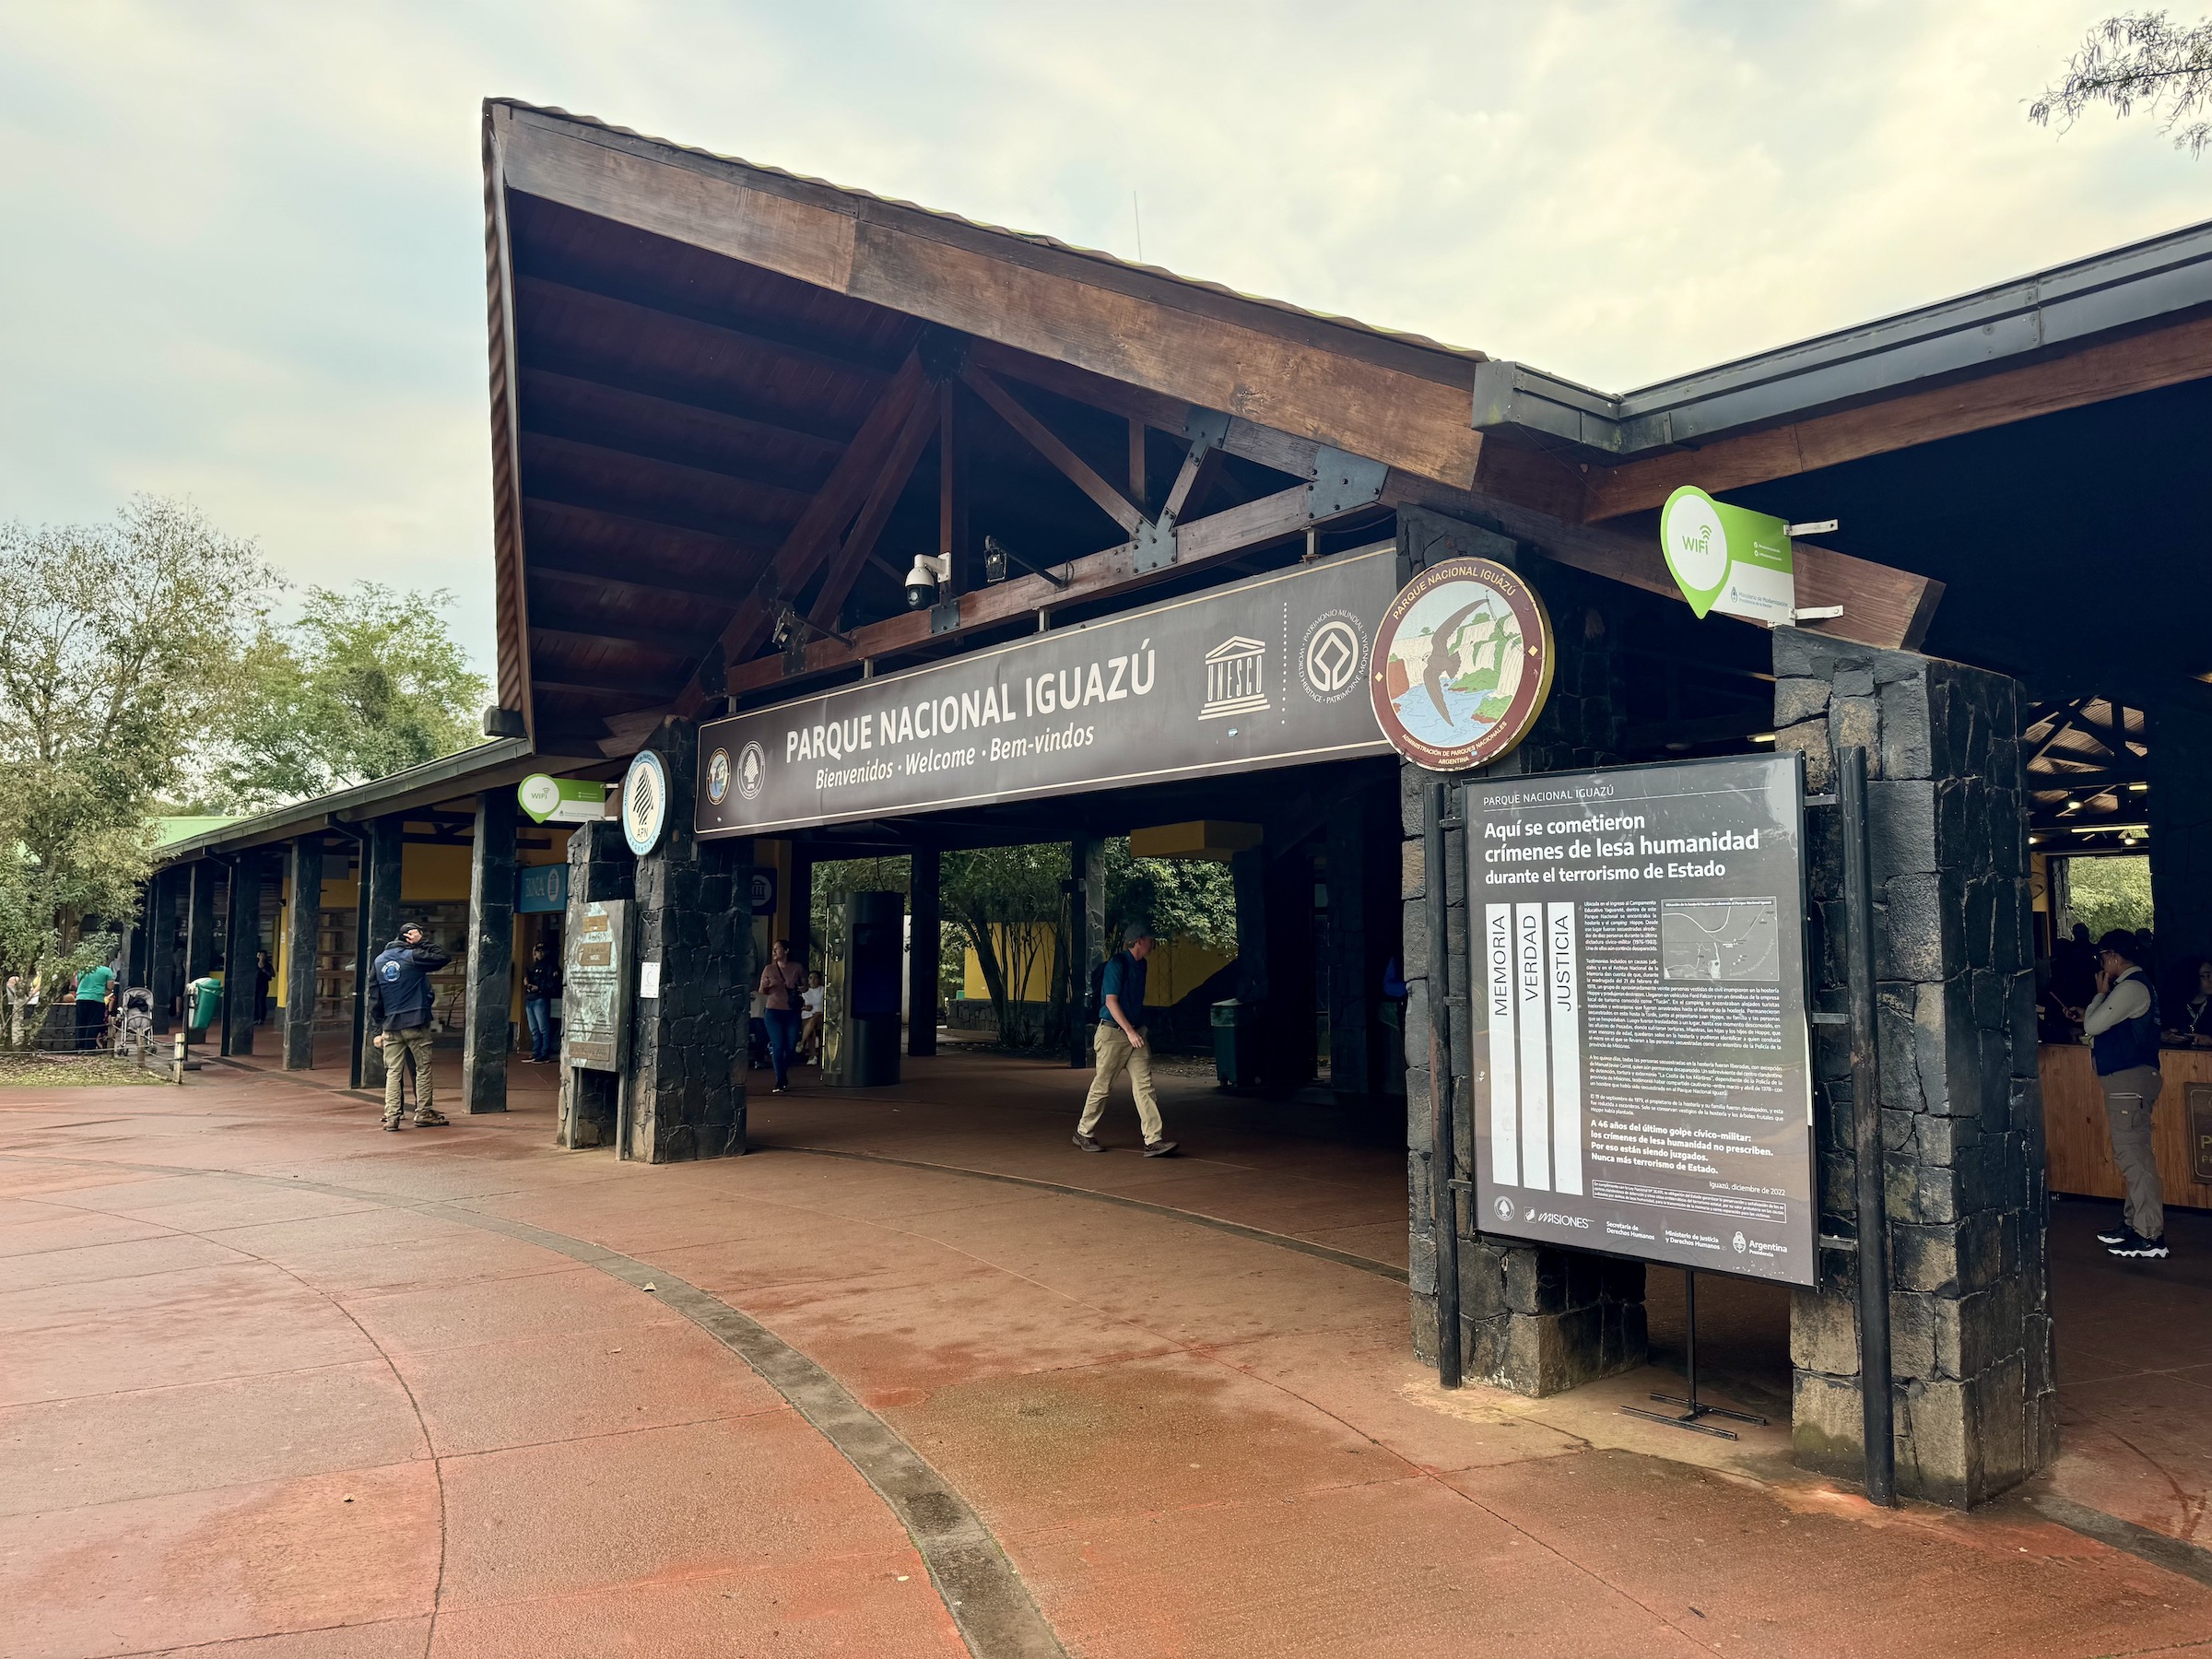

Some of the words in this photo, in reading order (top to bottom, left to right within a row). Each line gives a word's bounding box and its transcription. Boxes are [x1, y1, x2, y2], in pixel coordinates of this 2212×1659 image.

[1392, 582, 1428, 620] PARQUE
[1428, 566, 1478, 586] NACIONAL
[1480, 568, 1516, 596] IGUAZÚ
[1303, 609, 1337, 642] PATRIMONIO
[1337, 609, 1364, 632] MUNDIAL
[1207, 654, 1263, 702] UNESCO
[1326, 674, 1362, 704] PATRIMOINE
[1359, 631, 1369, 675] MONDIAL
[785, 714, 872, 764] PARQUE
[879, 683, 1016, 747] NACIONAL
[1025, 638, 1156, 718] IGUAZÚ
[1300, 677, 1323, 704] HERITAGE
[1401, 734, 1442, 757] ADMINISTRACIÓN
[1450, 745, 1476, 757] PARQUES
[1475, 721, 1507, 751] NACIONALES
[815, 758, 894, 791] Bienvenidos
[904, 745, 976, 776] Welcome
[989, 722, 1096, 762] Bem-vindos
[1438, 756, 1470, 765] ARGENTINA
[1484, 794, 1520, 806] PARQUE
[1523, 790, 1572, 802] NACIONAL
[1576, 784, 1614, 798] IGUAZÚ
[636, 828, 648, 838] APN
[1484, 820, 1521, 841] Aquí
[1525, 824, 1543, 836] se
[1547, 813, 1645, 834] cometieron
[1485, 843, 1564, 862] crímenes
[1568, 840, 1591, 859] de
[1597, 839, 1634, 857] lesa
[1640, 828, 1759, 855] humanidad
[1485, 869, 1539, 884] durante
[1543, 867, 1555, 882] el
[1558, 865, 1639, 882] terrorismo
[1643, 863, 1663, 879] de
[1668, 860, 1726, 878] Estado
[1492, 915, 1508, 1016] MEMORIA
[1523, 916, 1538, 1001] VERDAD
[1555, 915, 1571, 1012] JUSTICIA
[1591, 1130, 1602, 1139] los
[1603, 1132, 1637, 1142] crímenes
[1638, 1135, 1648, 1144] de
[1650, 1136, 1665, 1145] lesa
[1667, 1137, 1712, 1150] humanidad
[1726, 1146, 1774, 1156] prescriben.
[1609, 1122, 1628, 1130] años
[1629, 1123, 1641, 1131] del
[1642, 1124, 1668, 1134] último
[1669, 1127, 1692, 1138] golpe
[1693, 1129, 1751, 1142] cívico-militar:
[1591, 1141, 1604, 1150] Por
[1620, 1145, 1641, 1154] están
[1642, 1147, 1669, 1157] siendo
[1670, 1149, 1708, 1161] juzgados.
[1591, 1152, 1615, 1162] Nunca
[1616, 1156, 1632, 1164] más
[1633, 1157, 1675, 1169] terrorismo
[1676, 1162, 1686, 1171] de
[1688, 1163, 1718, 1174] Estado.
[1709, 1181, 1731, 1190] Iguazú,
[1731, 1184, 1760, 1193] diciembre
[1770, 1188, 1785, 1196] 2022
[1606, 1221, 1631, 1230] Secretaría
[1607, 1227, 1630, 1236] Derechos
[1630, 1231, 1655, 1240] Humanos
[1665, 1230, 1691, 1239] Ministerio
[1699, 1235, 1719, 1243] Justicia
[1670, 1237, 1694, 1246] Derechos
[1695, 1241, 1720, 1250] Humanos
[1749, 1240, 1788, 1253] Argentina
[1749, 1249, 1774, 1257] Presidencia
